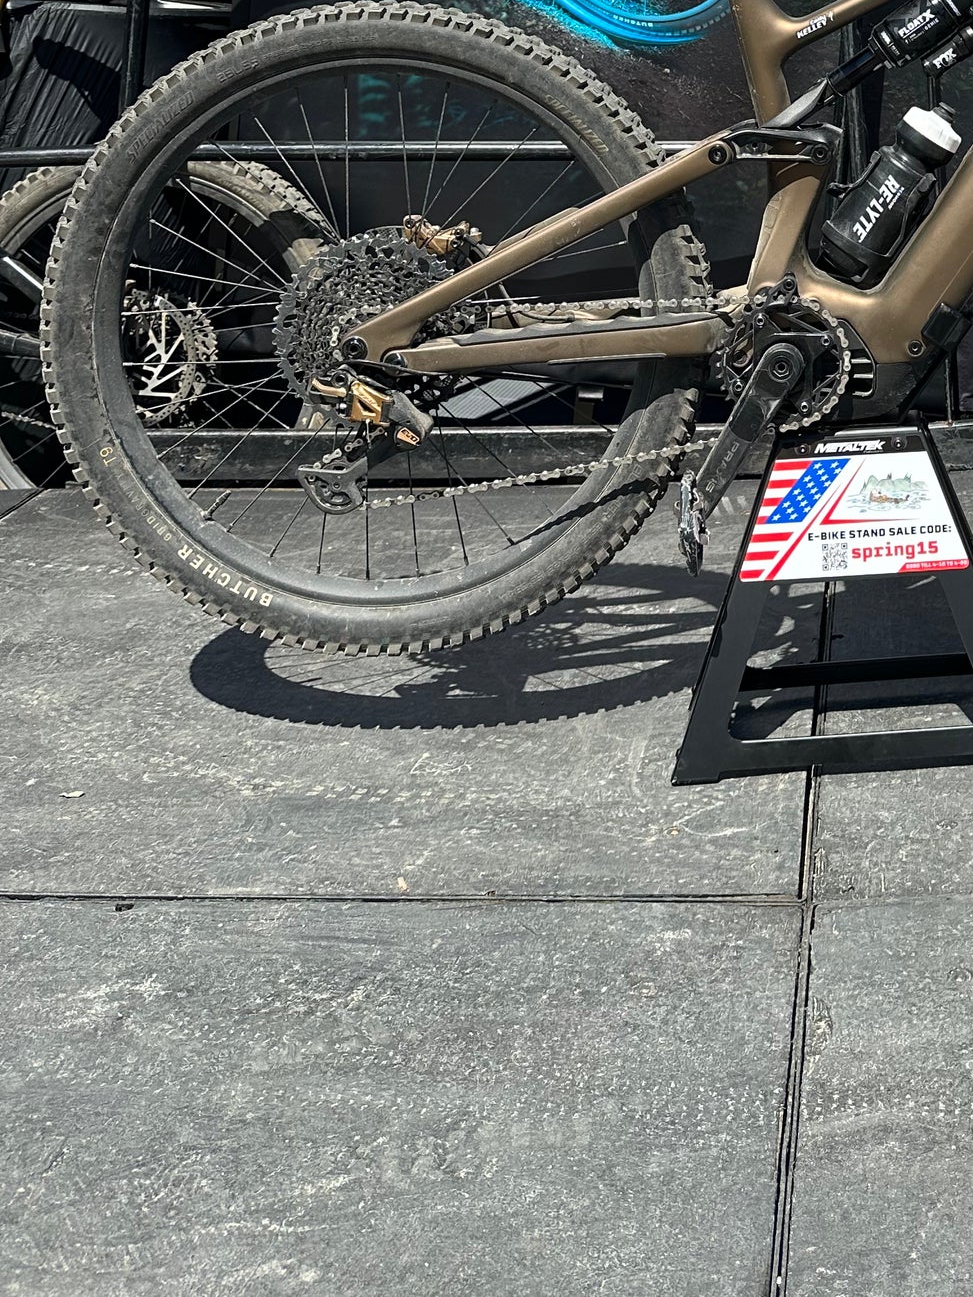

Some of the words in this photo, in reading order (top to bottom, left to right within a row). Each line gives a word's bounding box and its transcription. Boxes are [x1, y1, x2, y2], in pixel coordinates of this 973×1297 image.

[797, 20, 827, 39] KELLEY
[932, 47, 957, 69] FOX
[852, 174, 901, 243] RE-LYTE
[100, 446, 117, 468] T9
[814, 440, 886, 454] METALTEK
[808, 530, 846, 541] E-BIKE
[849, 528, 886, 539] STAND
[889, 526, 917, 536] SALE
[920, 524, 952, 534] CODE:
[851, 540, 939, 562] spring15
[178, 544, 274, 607] BUTCHER
